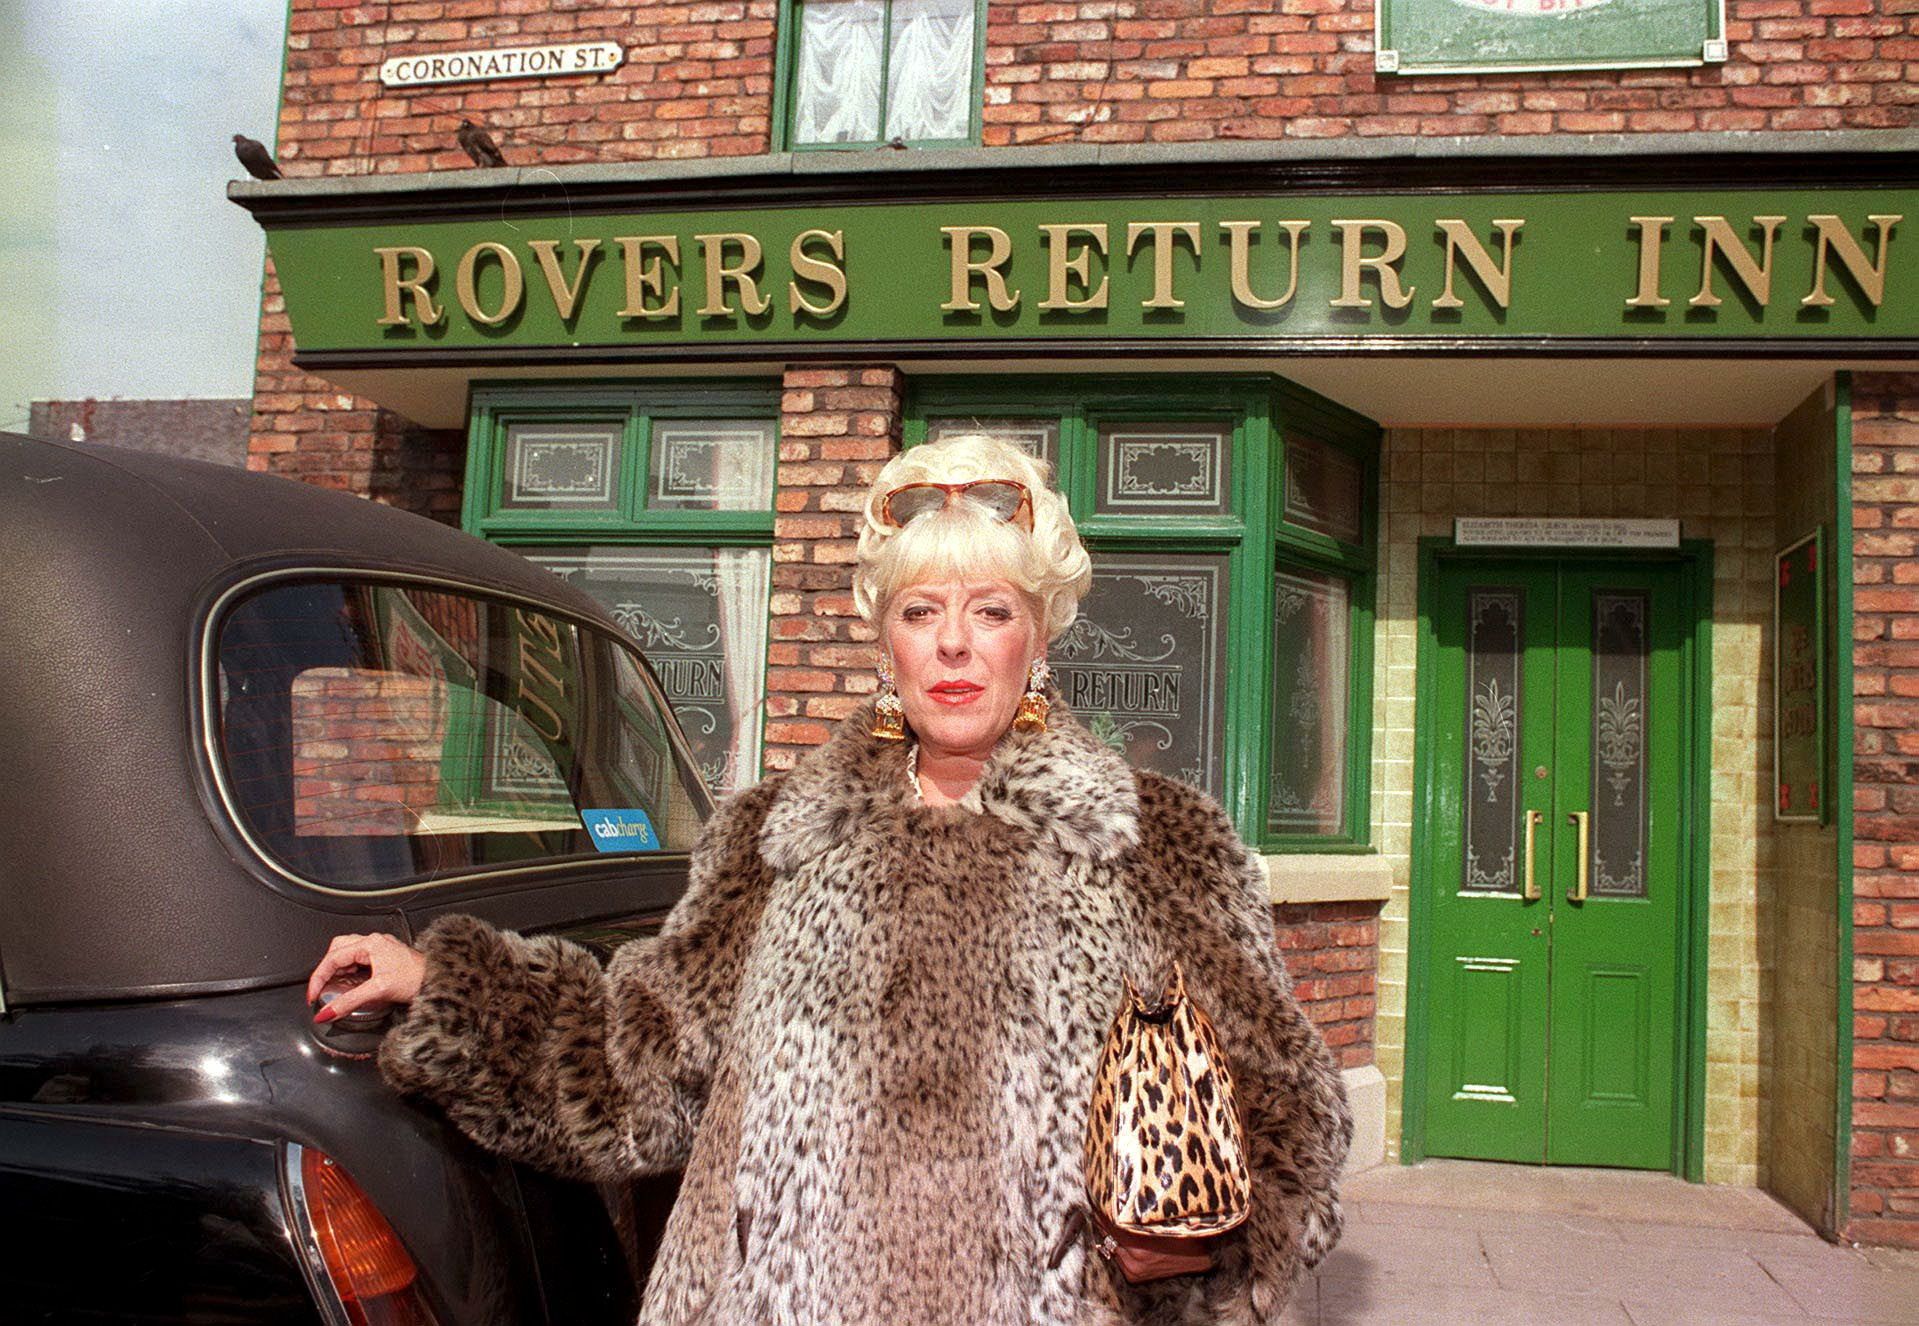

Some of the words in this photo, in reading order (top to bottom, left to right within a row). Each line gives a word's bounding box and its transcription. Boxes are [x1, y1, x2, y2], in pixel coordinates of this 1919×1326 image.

[395, 49, 565, 81] CORONATION
[574, 47, 606, 69] ST.
[373, 229, 848, 328] ROVERS
[938, 218, 1527, 313] RETURN
[1625, 213, 1904, 308] INN
[649, 657, 725, 697] TURN
[1071, 671, 1182, 712] RETURN
[594, 815, 649, 844] cabcharge
